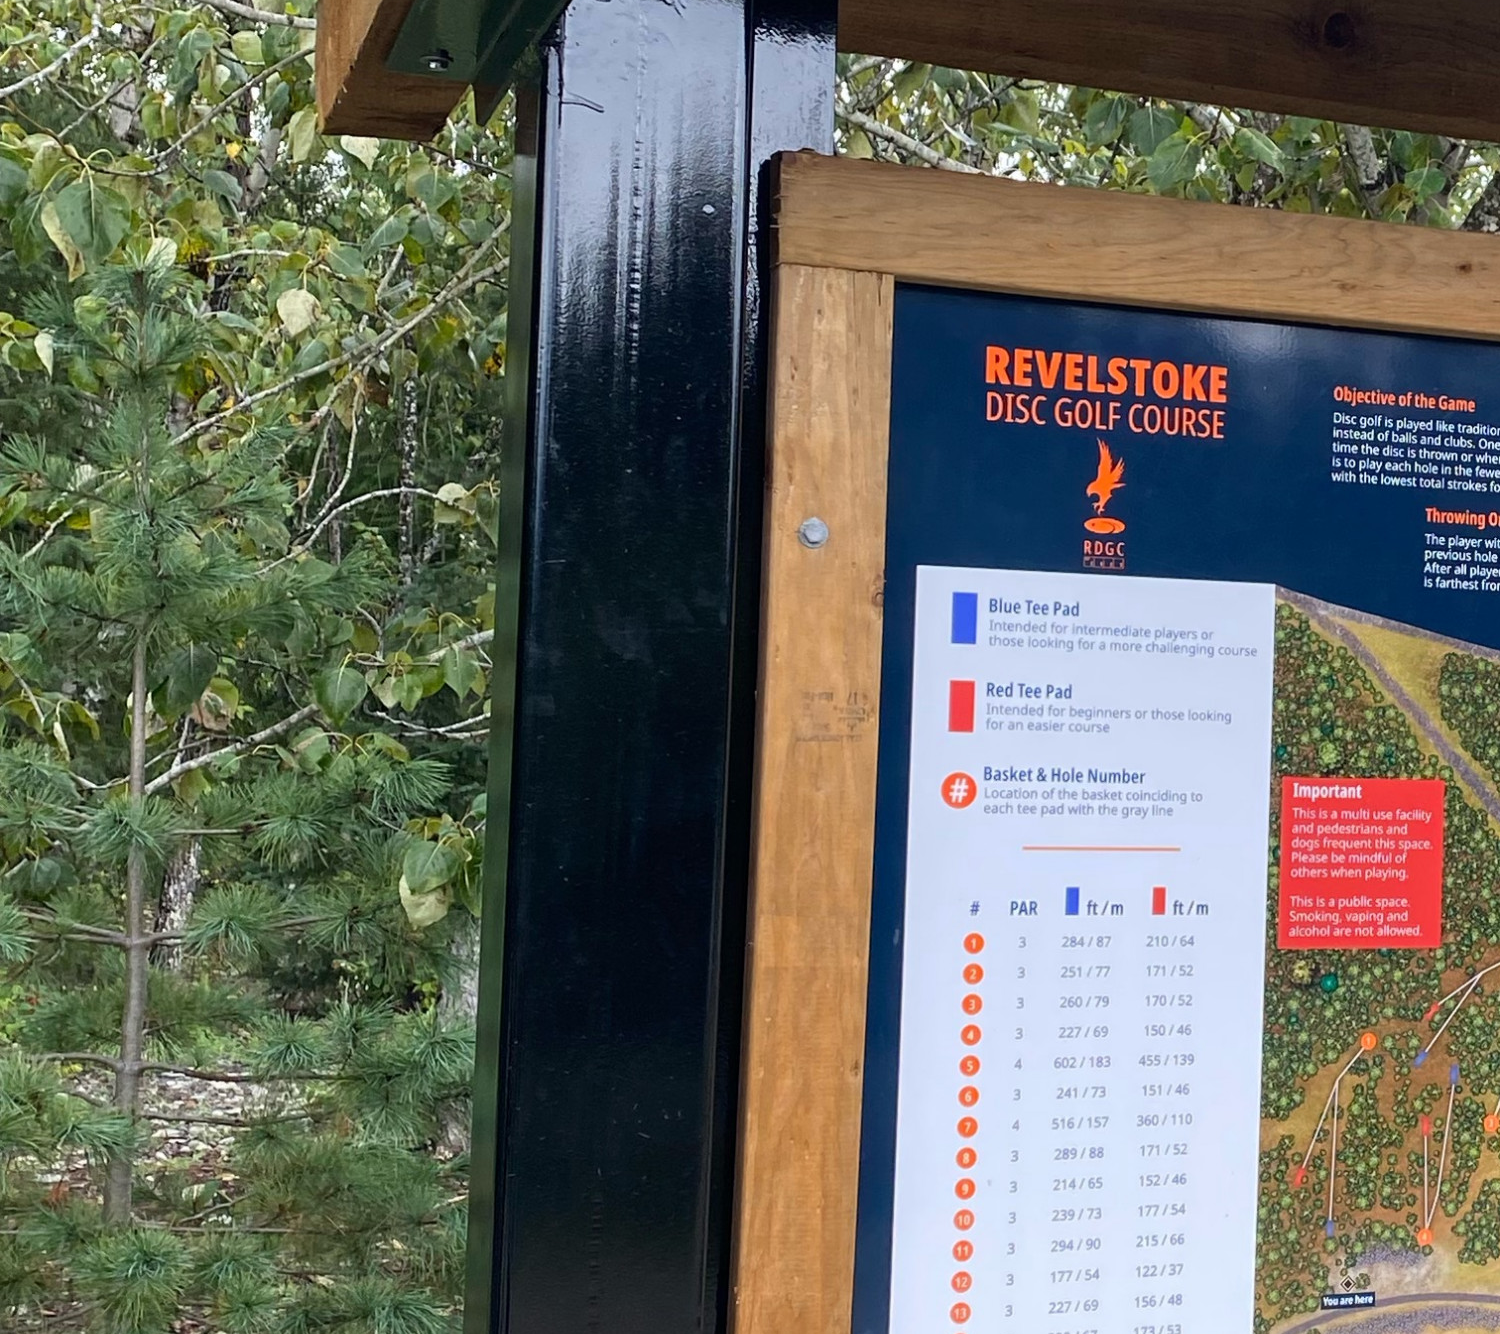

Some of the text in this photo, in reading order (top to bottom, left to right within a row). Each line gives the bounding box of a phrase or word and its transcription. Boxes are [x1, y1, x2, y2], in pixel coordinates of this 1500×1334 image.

[985, 346, 1228, 402] REVELSTOKE
[1333, 386, 1475, 412] Objective of the Game
[985, 392, 1225, 438] DISC GOLF COURSE
[1425, 507, 1486, 530] Throwing
[1083, 540, 1125, 556] RDGC
[989, 598, 1079, 616] Blue Tee Pad
[988, 620, 1214, 642] Intended for intermediate players or
[988, 634, 1257, 658] those looking for a more challenging course
[986, 681, 1072, 699] Red Tee Pad
[986, 703, 1232, 725] Intended for beginners or those looking
[985, 717, 1110, 733] for an easier course
[983, 766, 1146, 783] Basket & Hole Number
[983, 788, 1203, 805] Location of the basket coinciding to
[1292, 783, 1362, 802] Important
[983, 802, 1173, 819] each tee pad with the gray line
[1291, 807, 1432, 824] This is a multi use facility
[1291, 822, 1408, 837] and pedestrians and
[1291, 836, 1433, 852] dogs frequent this space.
[1291, 851, 1407, 863] Please be mindful of
[1290, 866, 1408, 881] others when playing.
[1009, 902, 1038, 915] PAR
[1289, 895, 1410, 910] This is a public space.
[1288, 910, 1408, 925] Smoking, vaping and
[1288, 925, 1422, 936] alcohol are not allowed.
[1018, 937, 1027, 948] 3
[1322, 1295, 1373, 1306] You are here
